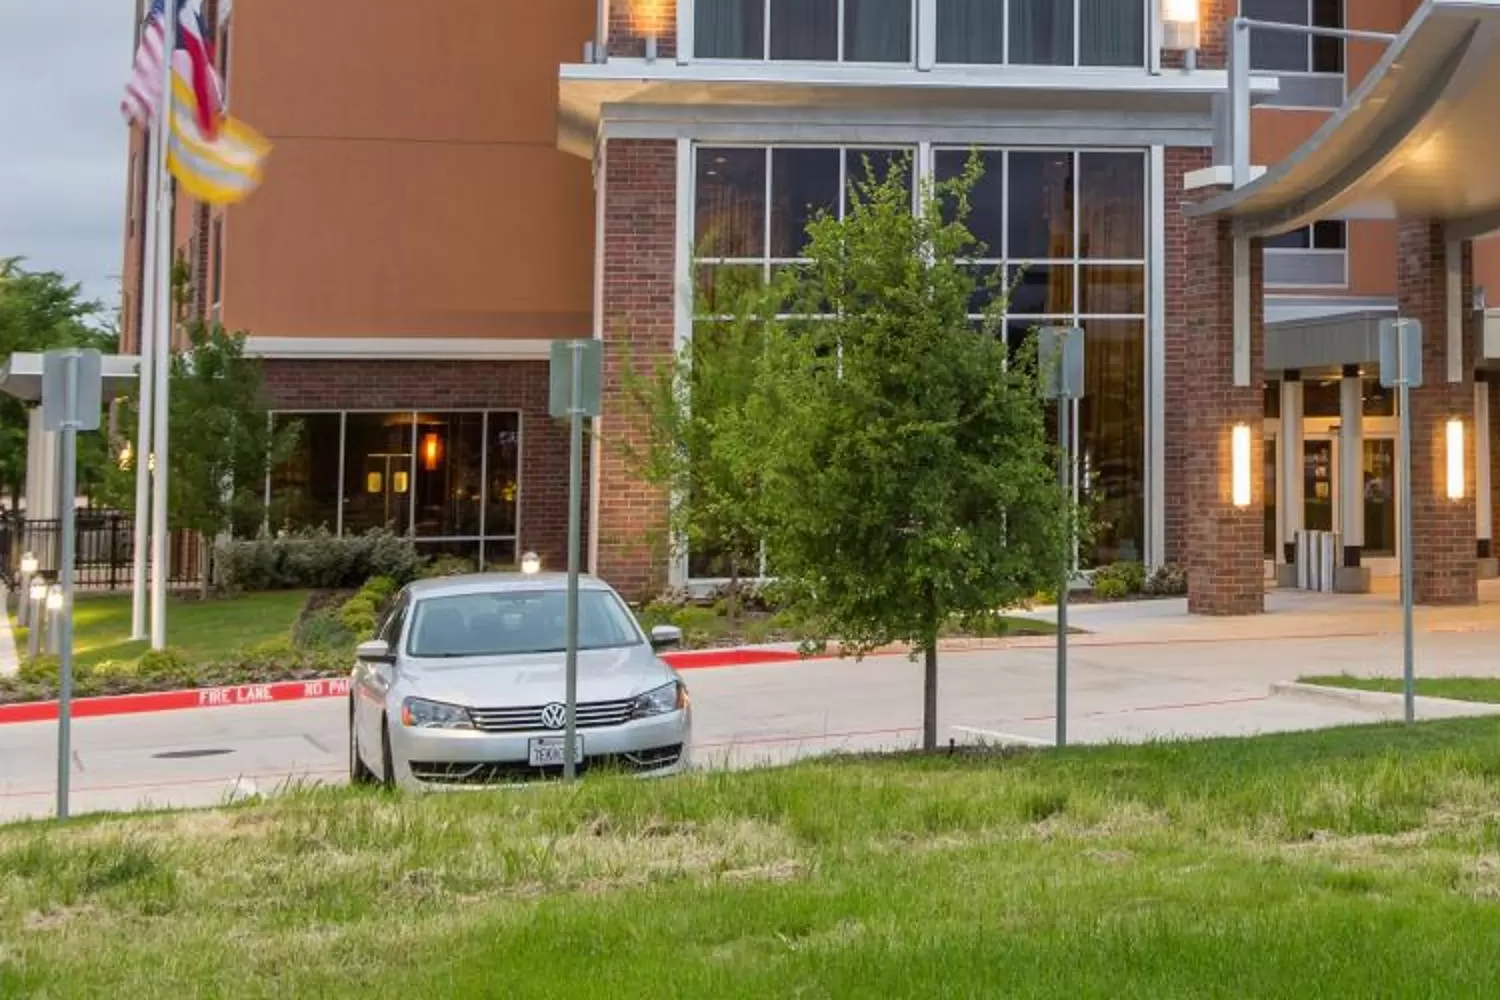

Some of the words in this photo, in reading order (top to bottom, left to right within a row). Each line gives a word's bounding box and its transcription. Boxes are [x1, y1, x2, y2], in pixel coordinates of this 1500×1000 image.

[200, 689, 232, 706] FIRE
[237, 685, 273, 703] LANE
[304, 681, 323, 697] NO
